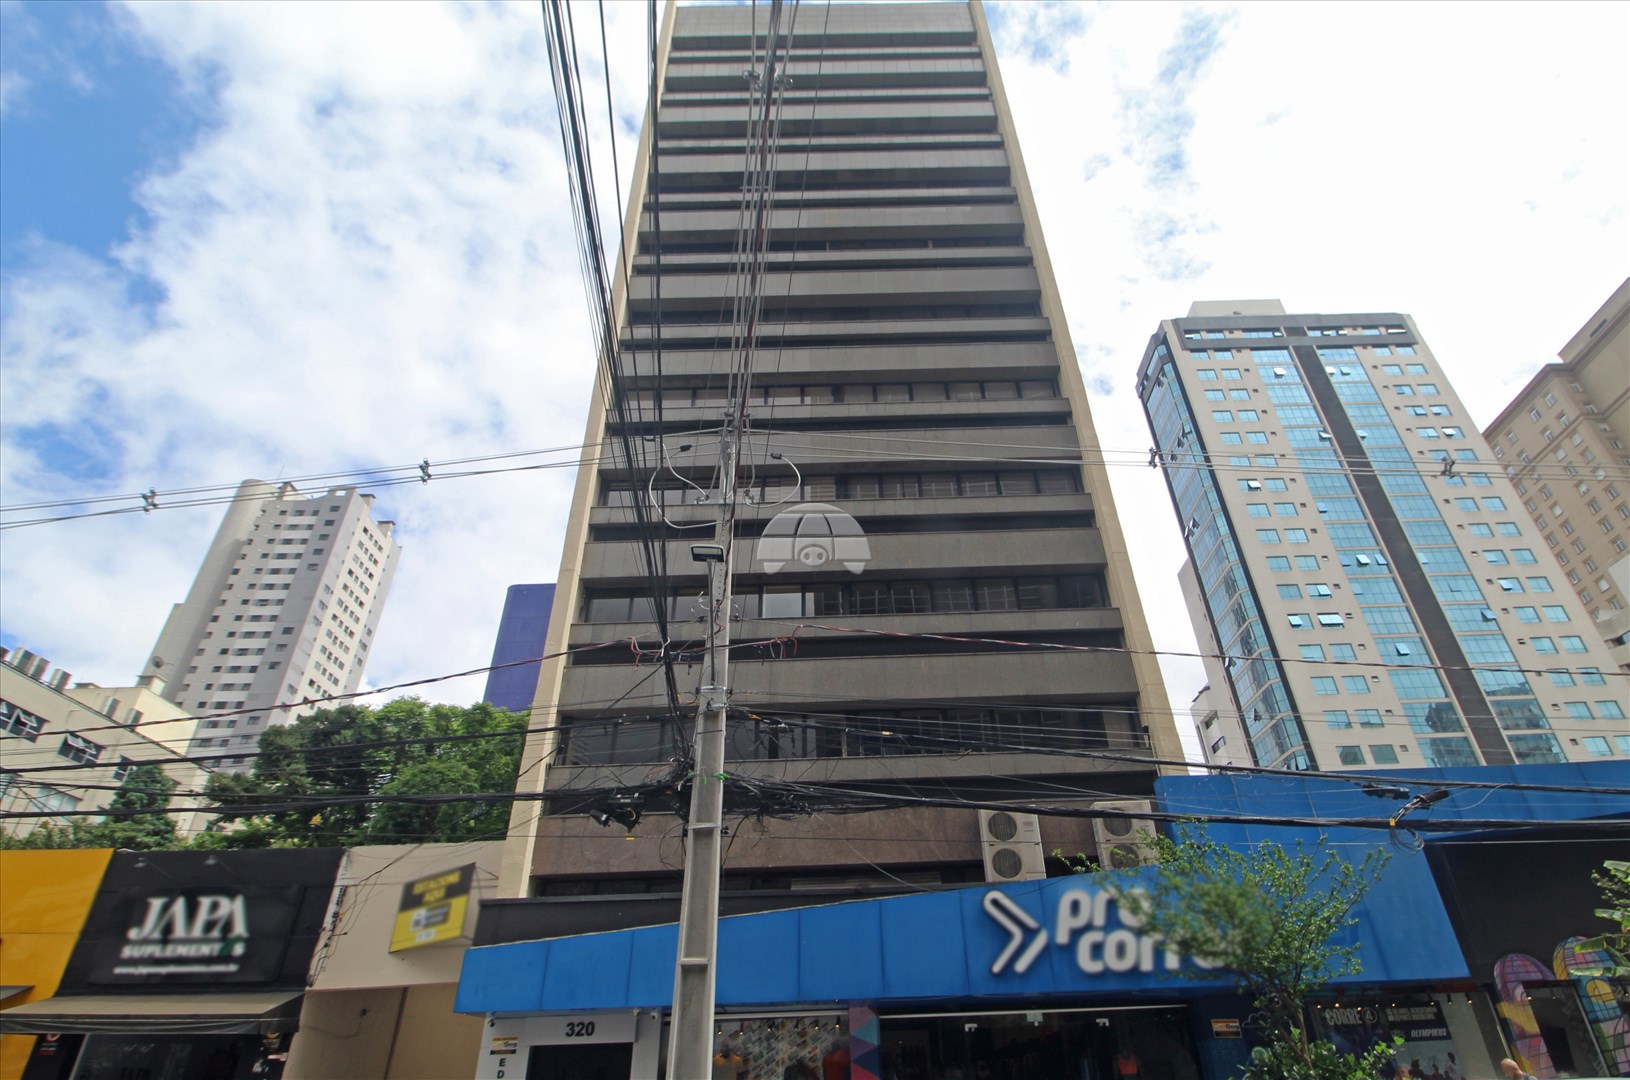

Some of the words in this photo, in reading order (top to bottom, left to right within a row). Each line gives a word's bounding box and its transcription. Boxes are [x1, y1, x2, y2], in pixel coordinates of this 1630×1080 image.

[126, 894, 250, 940] JAPA
[1056, 888, 1152, 945] pro
[120, 942, 245, 959] SUPLEMENTS
[1077, 929, 1247, 974] corr
[565, 1021, 596, 1037] 320
[1411, 1028, 1447, 1038] OLYMPIKUS
